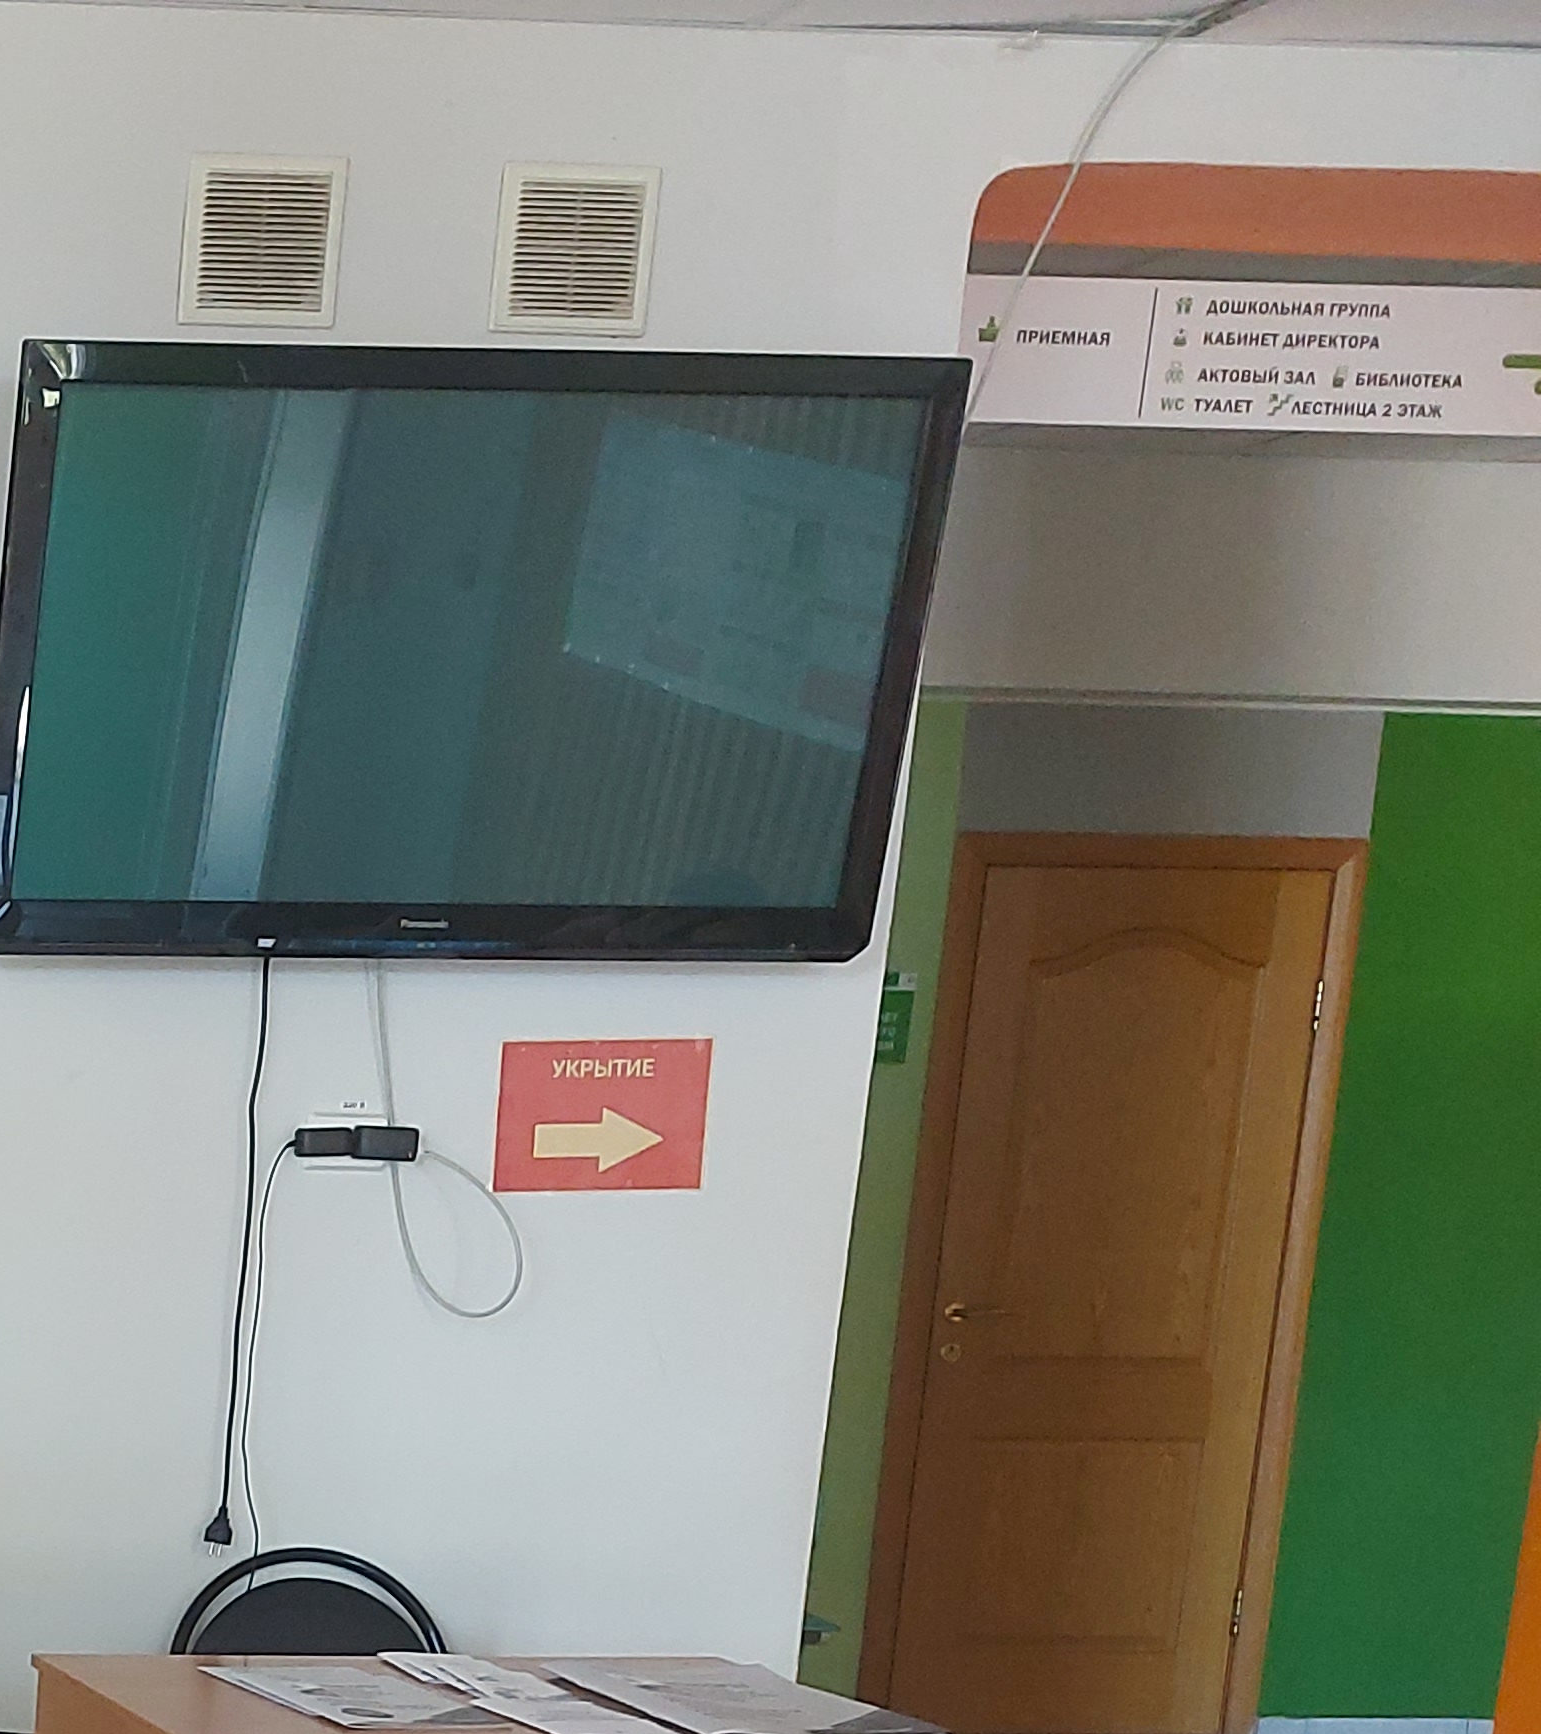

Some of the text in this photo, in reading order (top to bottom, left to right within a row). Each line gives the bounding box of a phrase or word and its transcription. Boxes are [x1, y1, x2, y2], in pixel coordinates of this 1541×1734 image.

[1206, 299, 1390, 318] ДОШКОЛЬНАЯ ГРУППА
[1016, 329, 1111, 347] ПРИЕМНАЯ
[1203, 331, 1379, 350] КАБИНЕТ ДИРЕКТОРА
[1197, 366, 1316, 386] АКТОВЫЙ ЗАЛ
[1355, 372, 1462, 388] БИБЛИОТЕКА
[1161, 398, 1184, 411] WC
[1194, 398, 1253, 414] ТУАЛЕТ
[1291, 401, 1442, 419] ЛЕСТНИЦА 2 ЭТАЖ
[552, 1058, 655, 1078] УКРЫТИЕ
